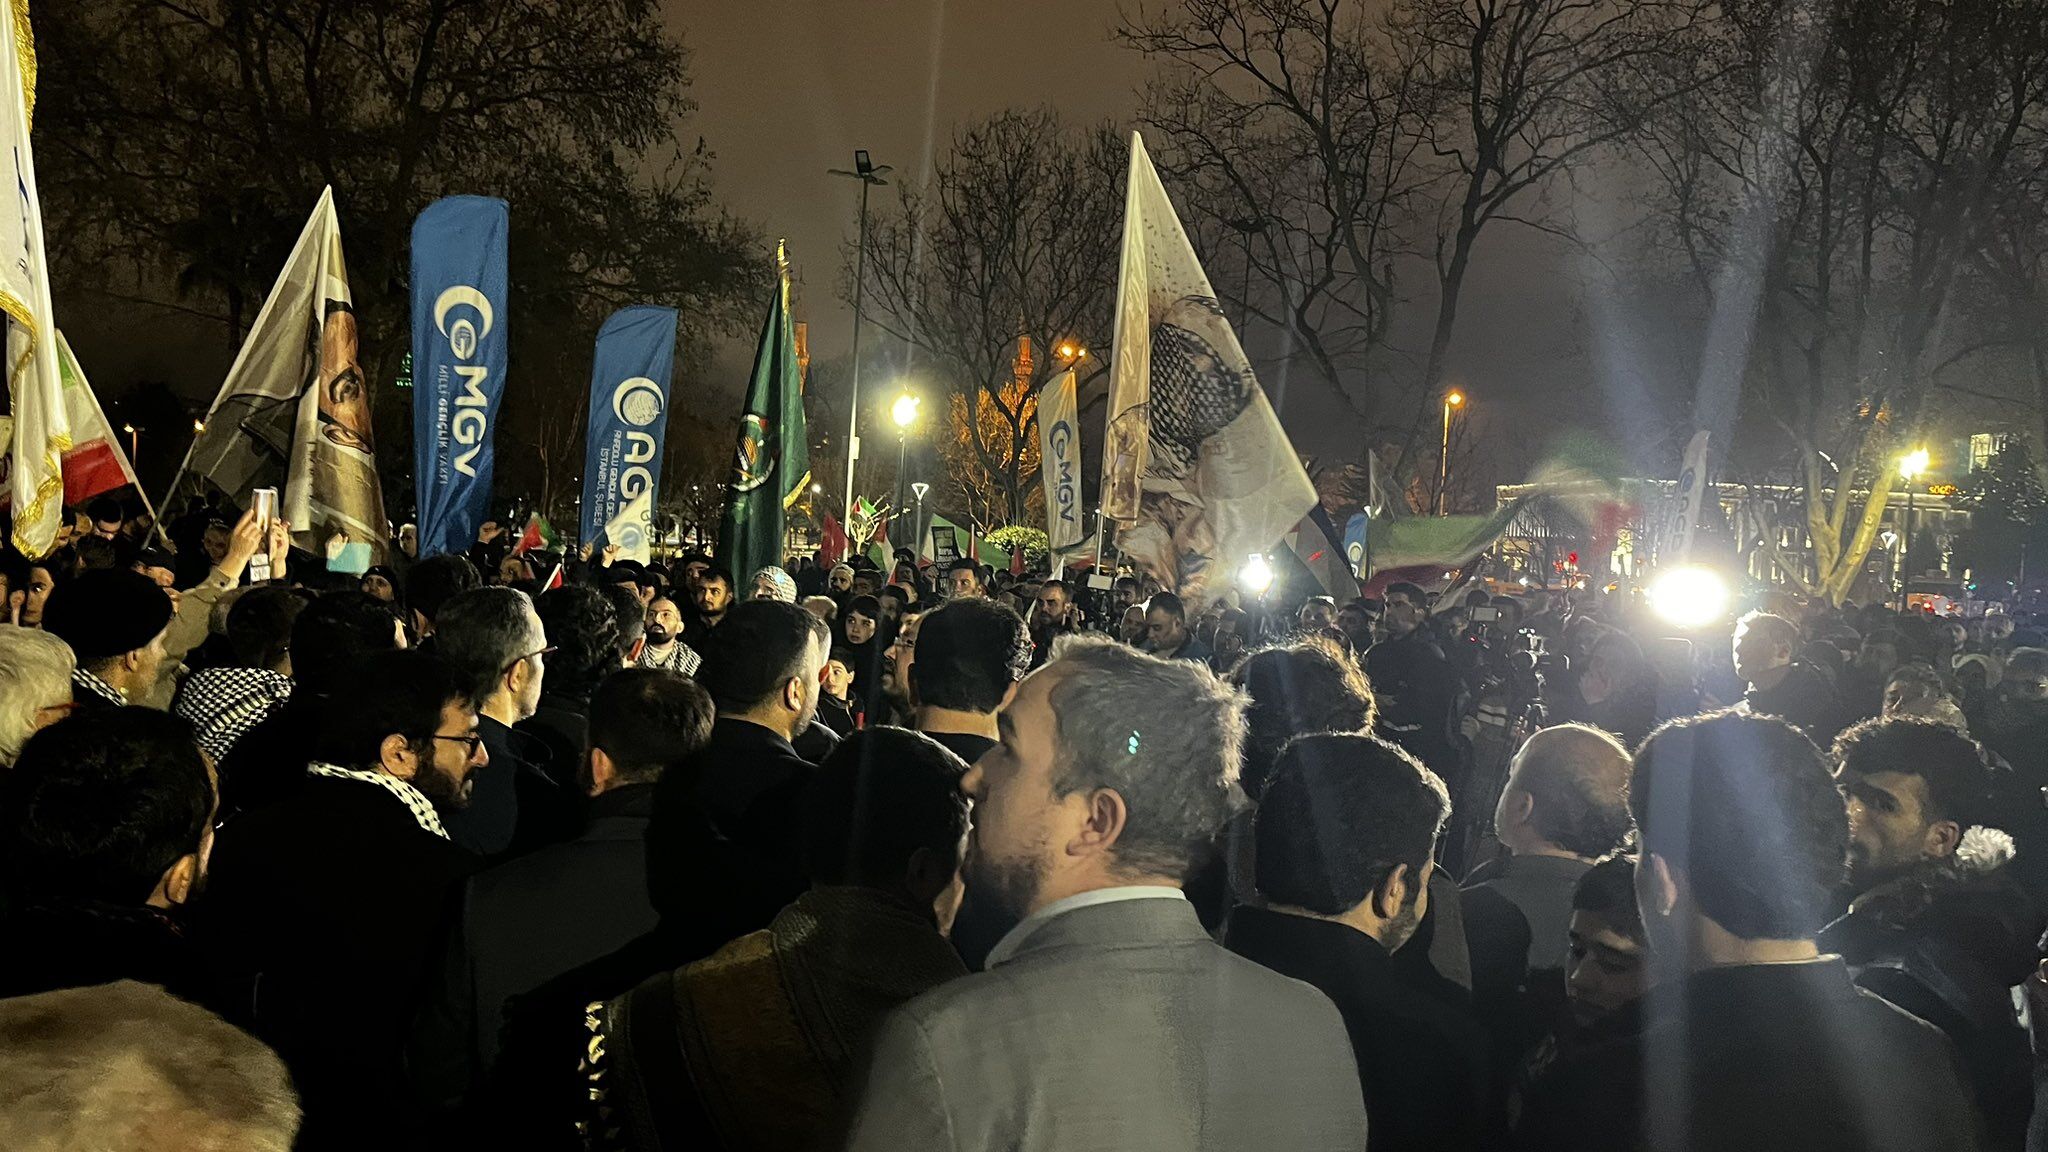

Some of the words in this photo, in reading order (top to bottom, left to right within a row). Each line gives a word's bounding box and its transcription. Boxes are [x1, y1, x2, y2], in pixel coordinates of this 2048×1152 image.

[452, 365, 488, 478] MGV
[597, 447, 610, 491] İSTANBUL
[1058, 461, 1074, 523] MGV
